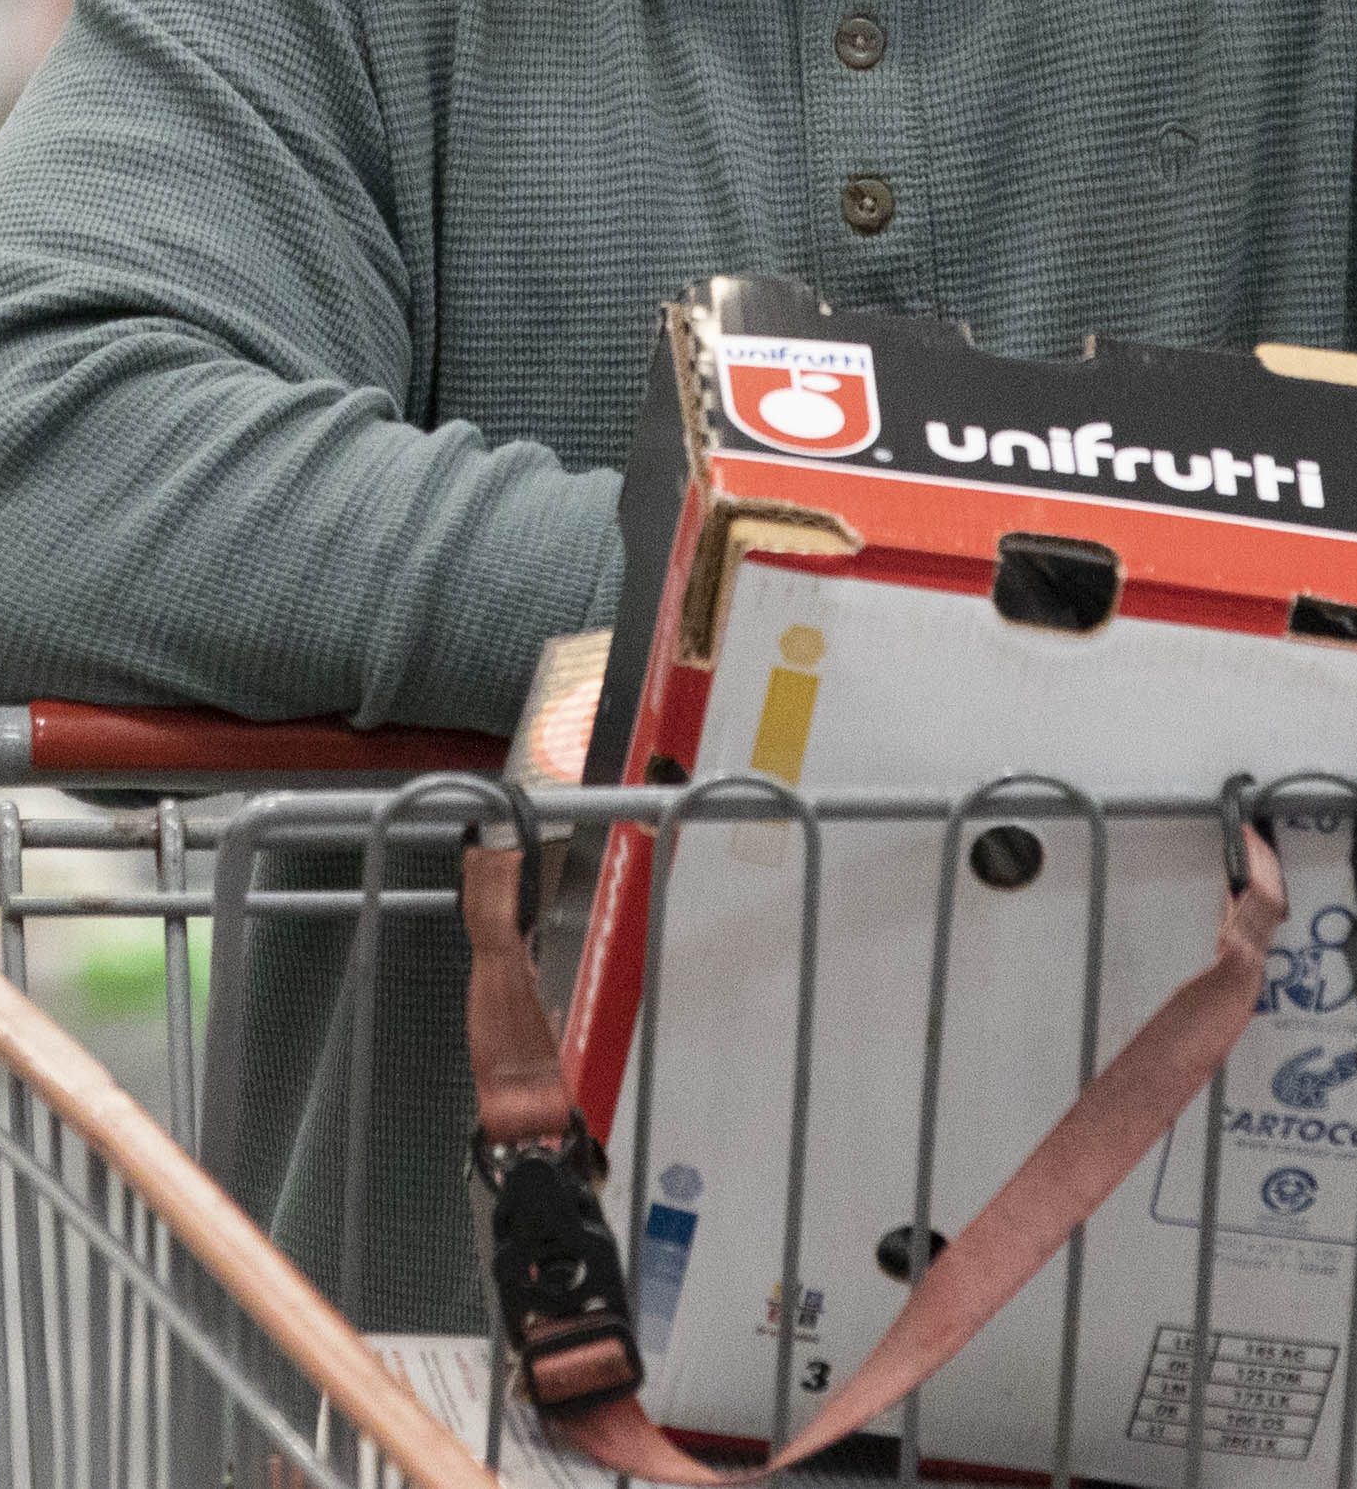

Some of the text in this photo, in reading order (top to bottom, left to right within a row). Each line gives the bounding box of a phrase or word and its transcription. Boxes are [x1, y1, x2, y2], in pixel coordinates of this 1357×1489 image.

[726, 347, 865, 373] unifrutti
[925, 420, 1325, 509] unifrutti
[800, 1360, 831, 1393] 3
